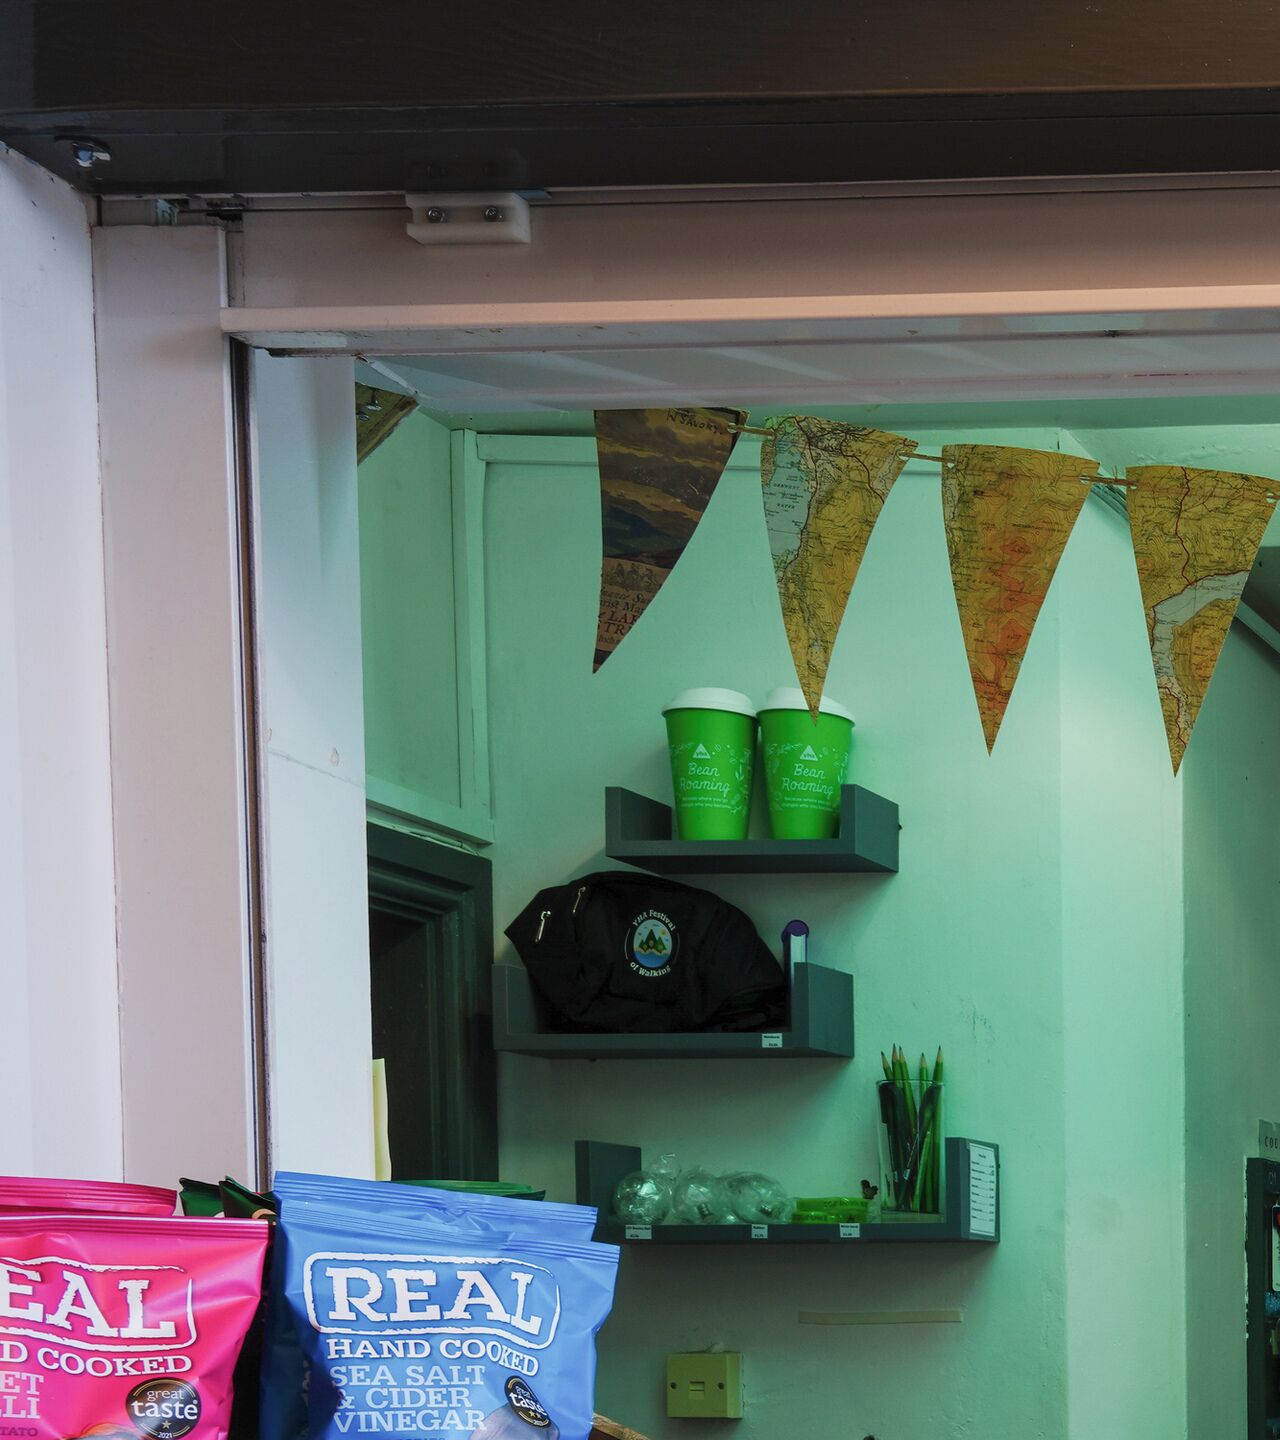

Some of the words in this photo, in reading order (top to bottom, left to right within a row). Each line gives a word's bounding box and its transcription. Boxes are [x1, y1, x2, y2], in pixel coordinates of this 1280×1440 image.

[688, 762, 721, 777] Bean
[793, 763, 826, 779] Bean
[680, 778, 731, 797] Roaming
[782, 777, 834, 799] Roaming
[649, 909, 676, 931] Festival
[639, 965, 672, 977] Walking
[325, 1266, 544, 1337] REAL
[38, 1346, 193, 1378] COOKED
[326, 1338, 431, 1360] HAND
[439, 1339, 540, 1378] COOKED
[329, 1365, 398, 1387] SEA
[405, 1365, 486, 1387] SALT
[147, 1388, 185, 1402] great
[365, 1388, 473, 1409] CIDER
[131, 1400, 199, 1422] taste
[333, 1410, 488, 1434] VINEGAR
